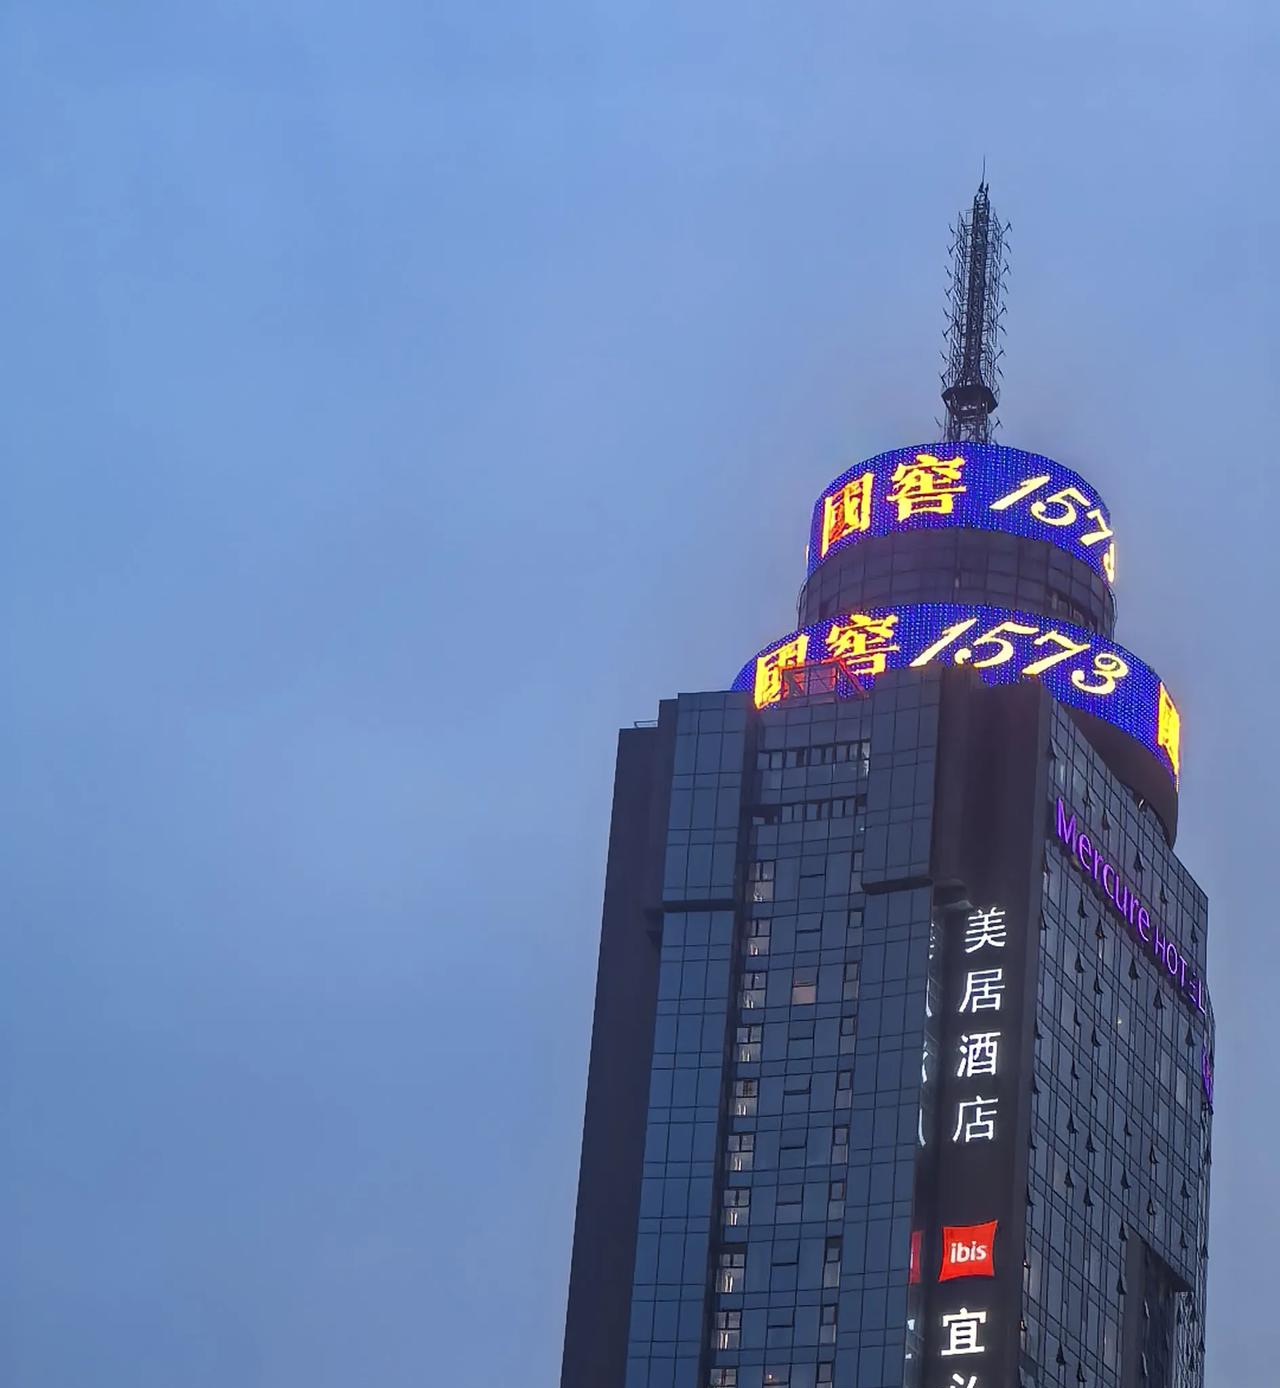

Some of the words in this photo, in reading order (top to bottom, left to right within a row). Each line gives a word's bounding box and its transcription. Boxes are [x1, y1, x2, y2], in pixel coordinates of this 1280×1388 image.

[909, 617, 1129, 695] 1573
[1056, 798, 1150, 942] Mercure
[952, 906, 1007, 1143] 美居酒店
[950, 1241, 987, 1264] ibis
